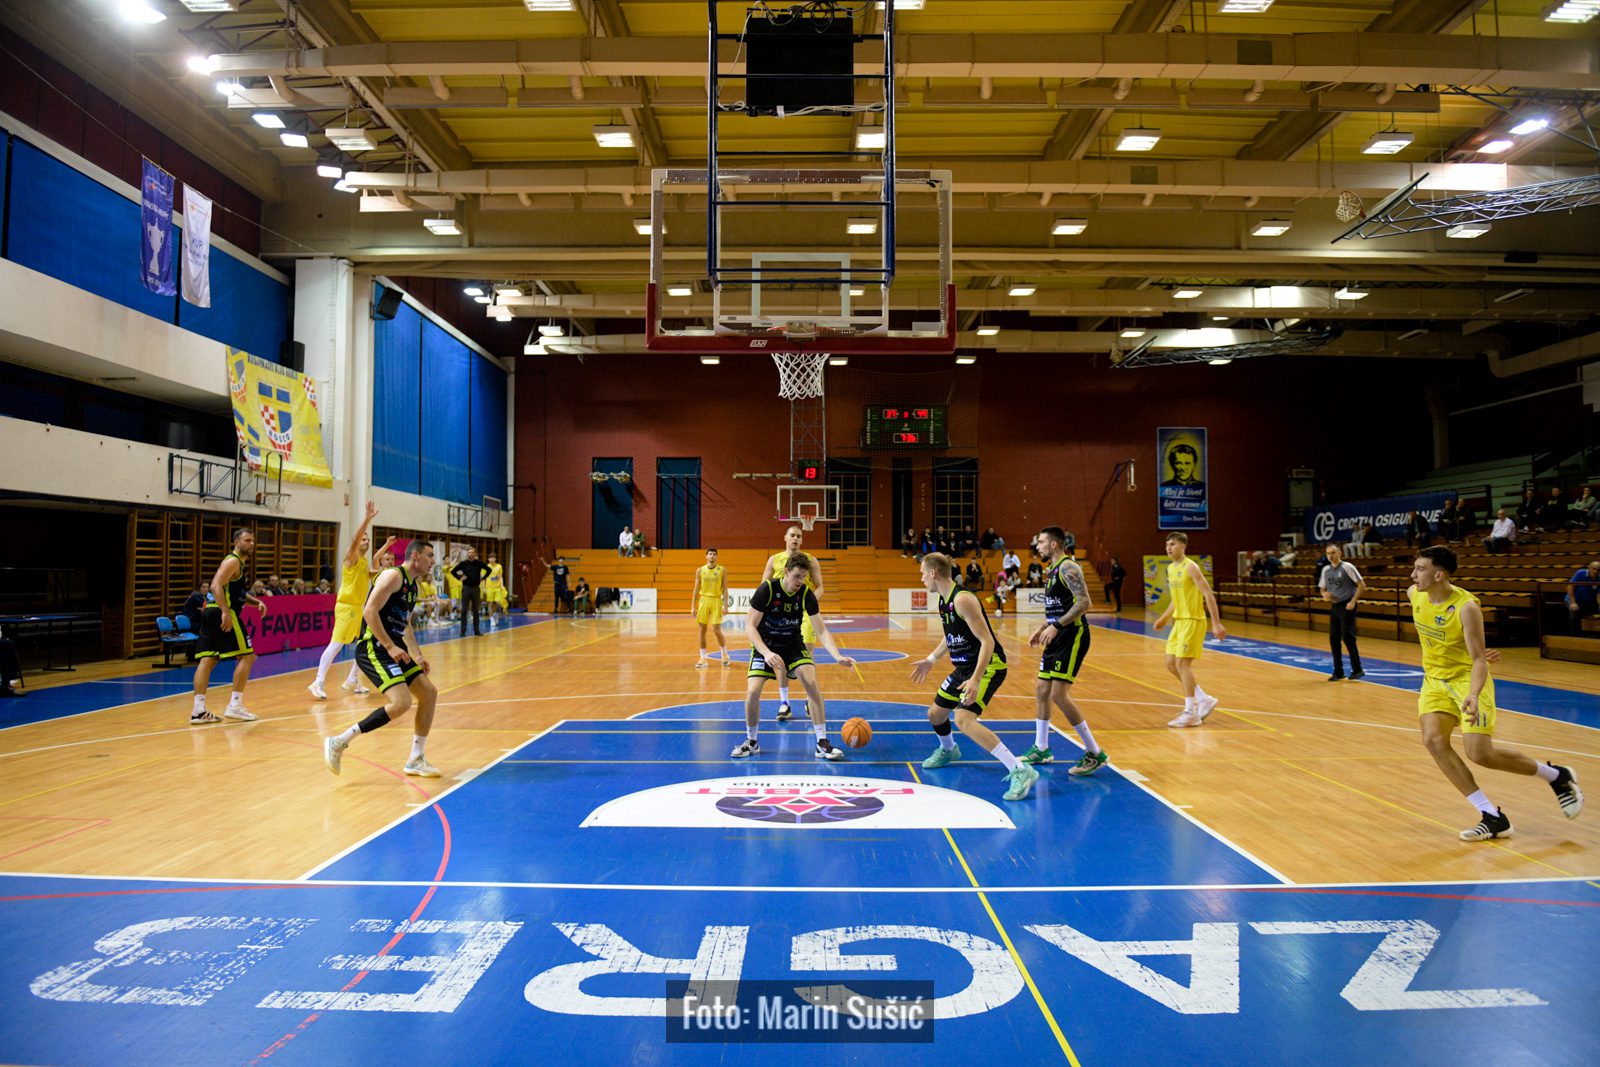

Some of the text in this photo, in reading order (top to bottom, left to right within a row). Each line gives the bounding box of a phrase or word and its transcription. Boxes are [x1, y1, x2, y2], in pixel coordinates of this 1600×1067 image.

[805, 467, 816, 479] 13
[783, 603, 793, 613] 15
[261, 610, 335, 638] FAVBET
[1054, 660, 1062, 671] 3
[685, 787, 915, 795] FAVBET
[29, 915, 1549, 1019] ZAGREB
